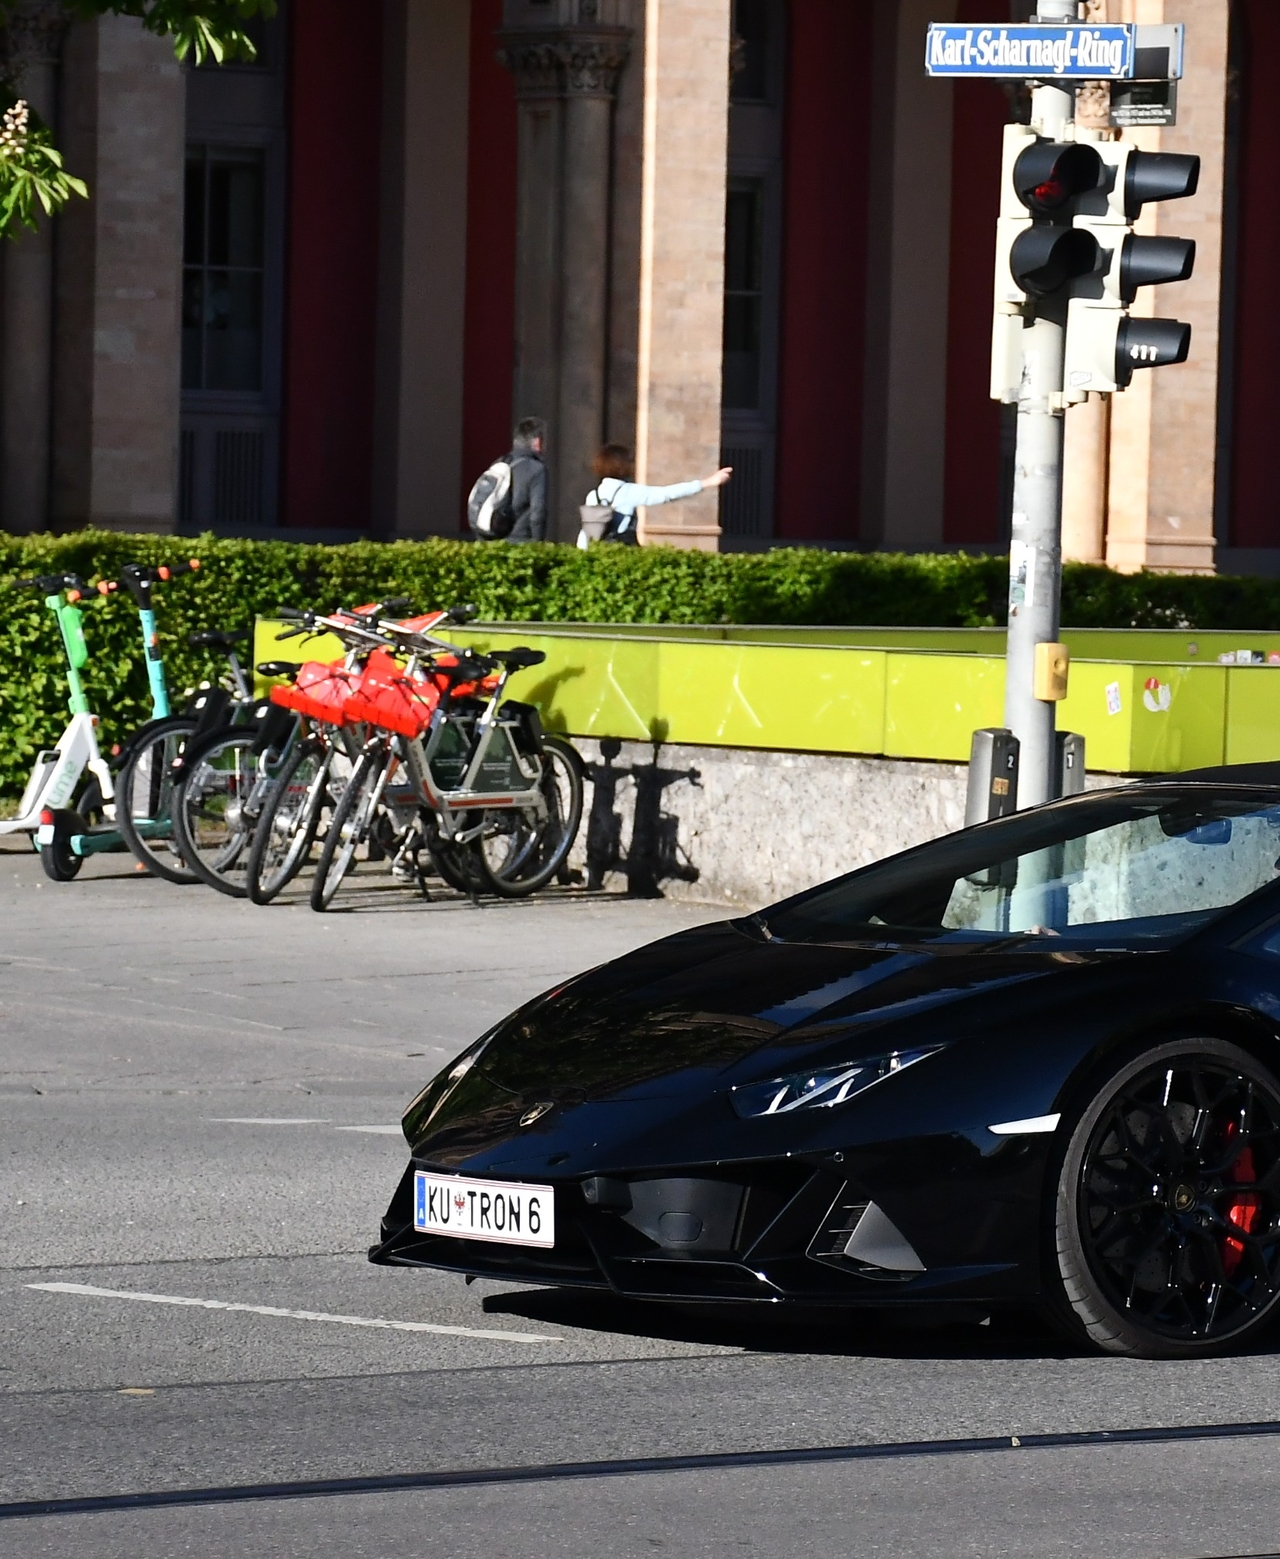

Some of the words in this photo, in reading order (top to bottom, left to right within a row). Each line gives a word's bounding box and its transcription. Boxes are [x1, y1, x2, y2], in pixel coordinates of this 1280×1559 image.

[930, 30, 1123, 74] Karl-Scharnagl-Ring
[1130, 344, 1158, 361] 411
[428, 1185, 450, 1224] KU
[467, 1190, 521, 1233] TRON
[528, 1197, 541, 1234] 6
